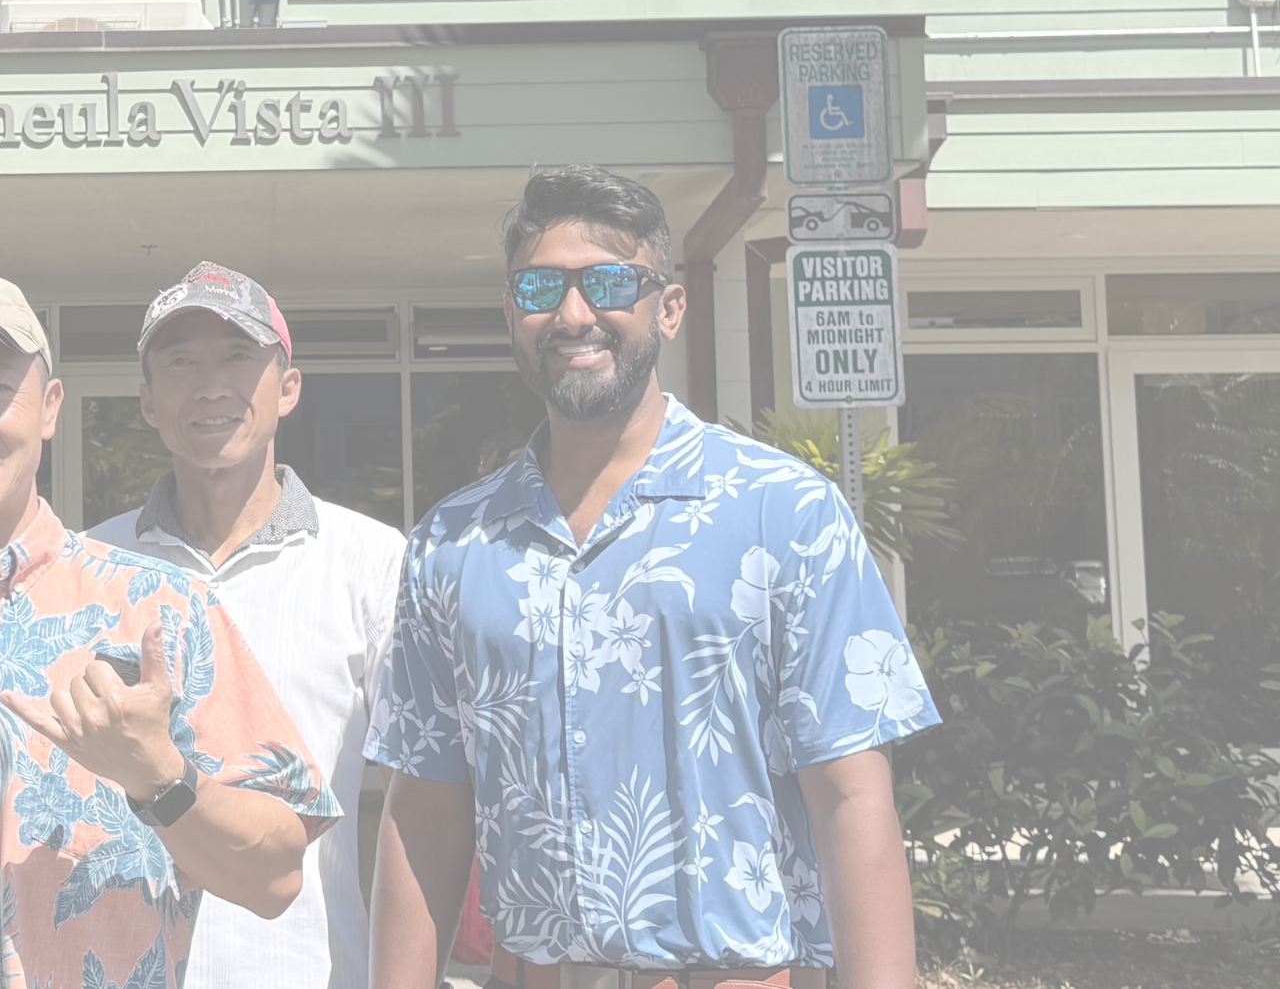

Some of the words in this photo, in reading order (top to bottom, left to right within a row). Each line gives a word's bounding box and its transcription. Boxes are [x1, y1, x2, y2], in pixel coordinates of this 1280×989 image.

[789, 42, 879, 62] RESERVED
[799, 63, 870, 84] PARKING
[170, 77, 353, 148] Vista
[372, 73, 461, 139] III
[801, 256, 883, 278] VISITOR
[798, 279, 889, 302] PARKING
[816, 310, 850, 327] 6AM
[858, 310, 874, 326] to
[807, 327, 884, 345] MIDNIGHT
[815, 348, 878, 375] ONLY
[805, 380, 813, 393] 4
[819, 379, 852, 393] HOUR
[858, 378, 892, 392] LIMIT
